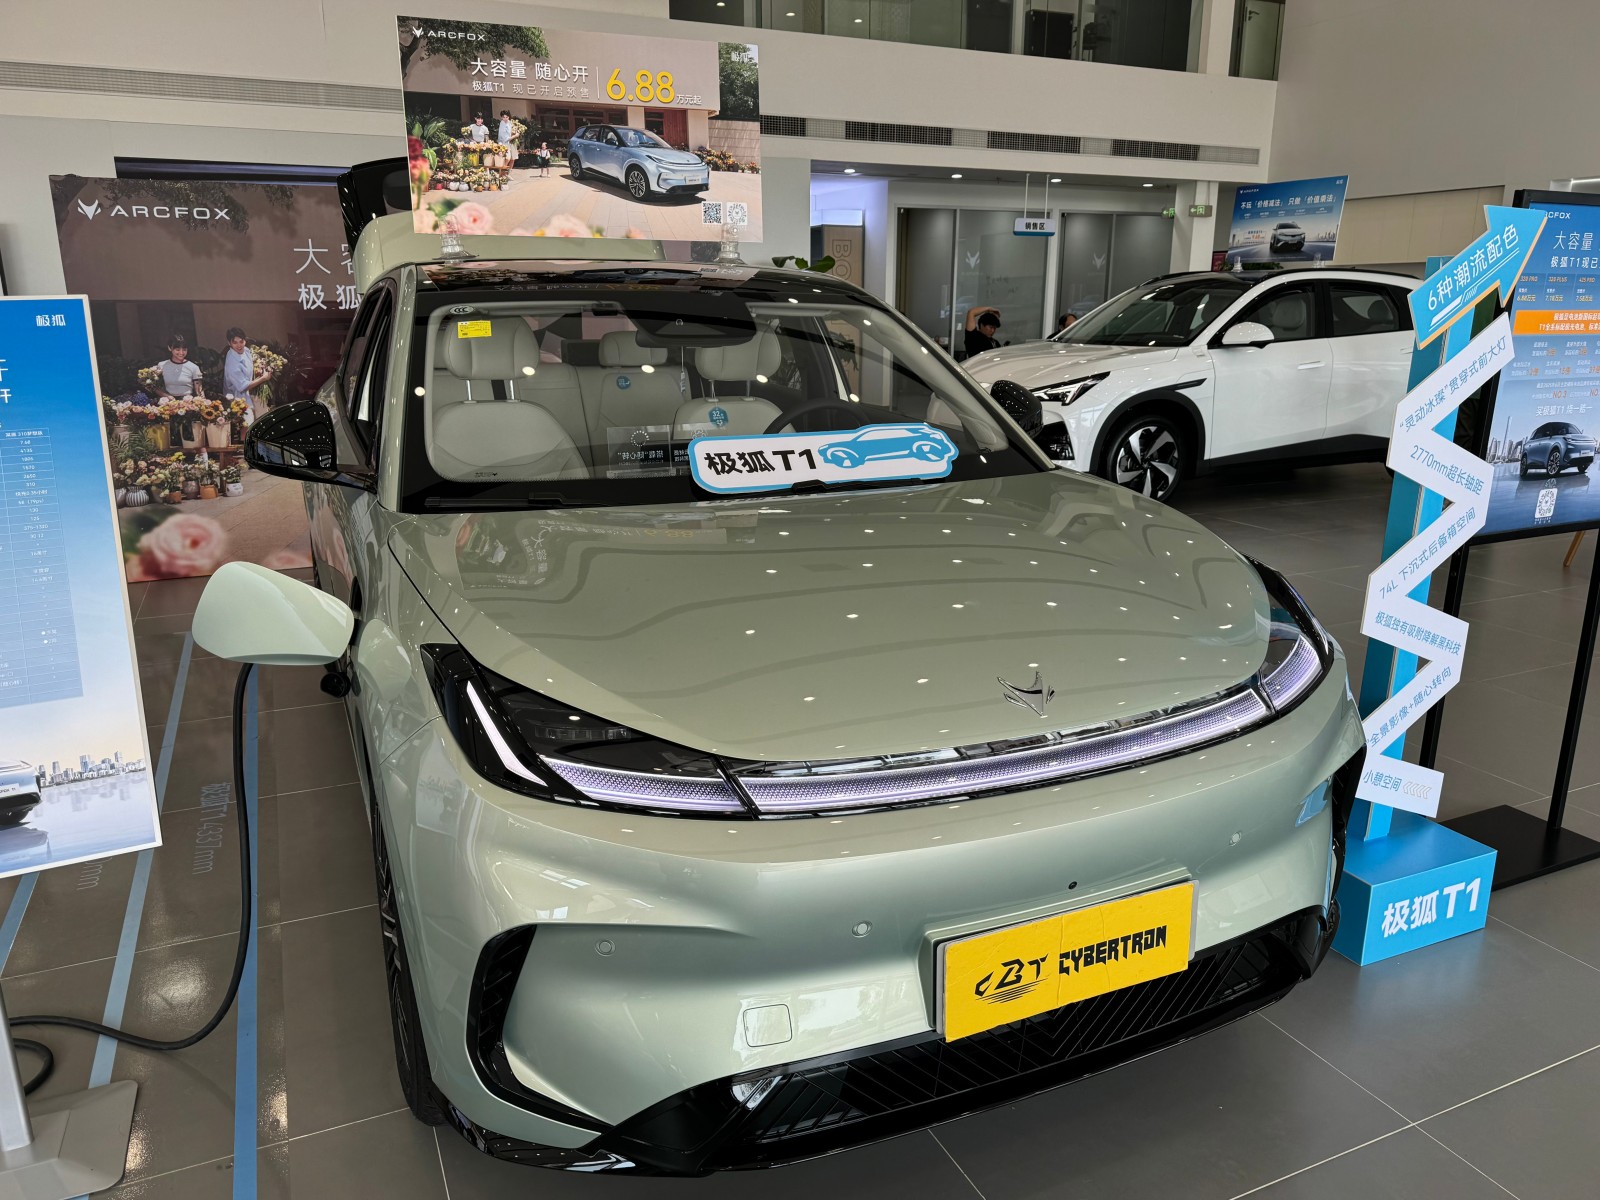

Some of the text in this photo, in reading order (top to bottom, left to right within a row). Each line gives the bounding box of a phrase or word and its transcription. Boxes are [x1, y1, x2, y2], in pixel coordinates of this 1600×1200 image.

[427, 30, 486, 42] ARCFOX
[471, 58, 589, 83] 大容量 随心开
[472, 80, 589, 98] 极狐T1 现已开启预售
[606, 68, 675, 103] 6.88
[677, 94, 702, 105] 万元起
[110, 204, 231, 220] ARCFOX
[1025, 222, 1046, 231] 销售区
[1552, 230, 1594, 251] 大容量
[1428, 222, 1520, 311] 6种潮流配色
[1550, 255, 1600, 269] 极狐T1现已
[297, 283, 361, 311] 极狐
[36, 314, 66, 327] 极狐
[704, 448, 817, 476] 极狐T1
[1410, 445, 1485, 496] 2770mm超长轴距
[1379, 507, 1476, 600] 74L 下沉式后备箱空间
[1375, 610, 1462, 656] 极狐独有吸附降解黑科技
[1363, 769, 1403, 792] 小憩空间
[192, 822, 223, 875] 4337mm
[1381, 877, 1481, 938] 极狐T1
[1058, 925, 1167, 976] CYBERTRON
